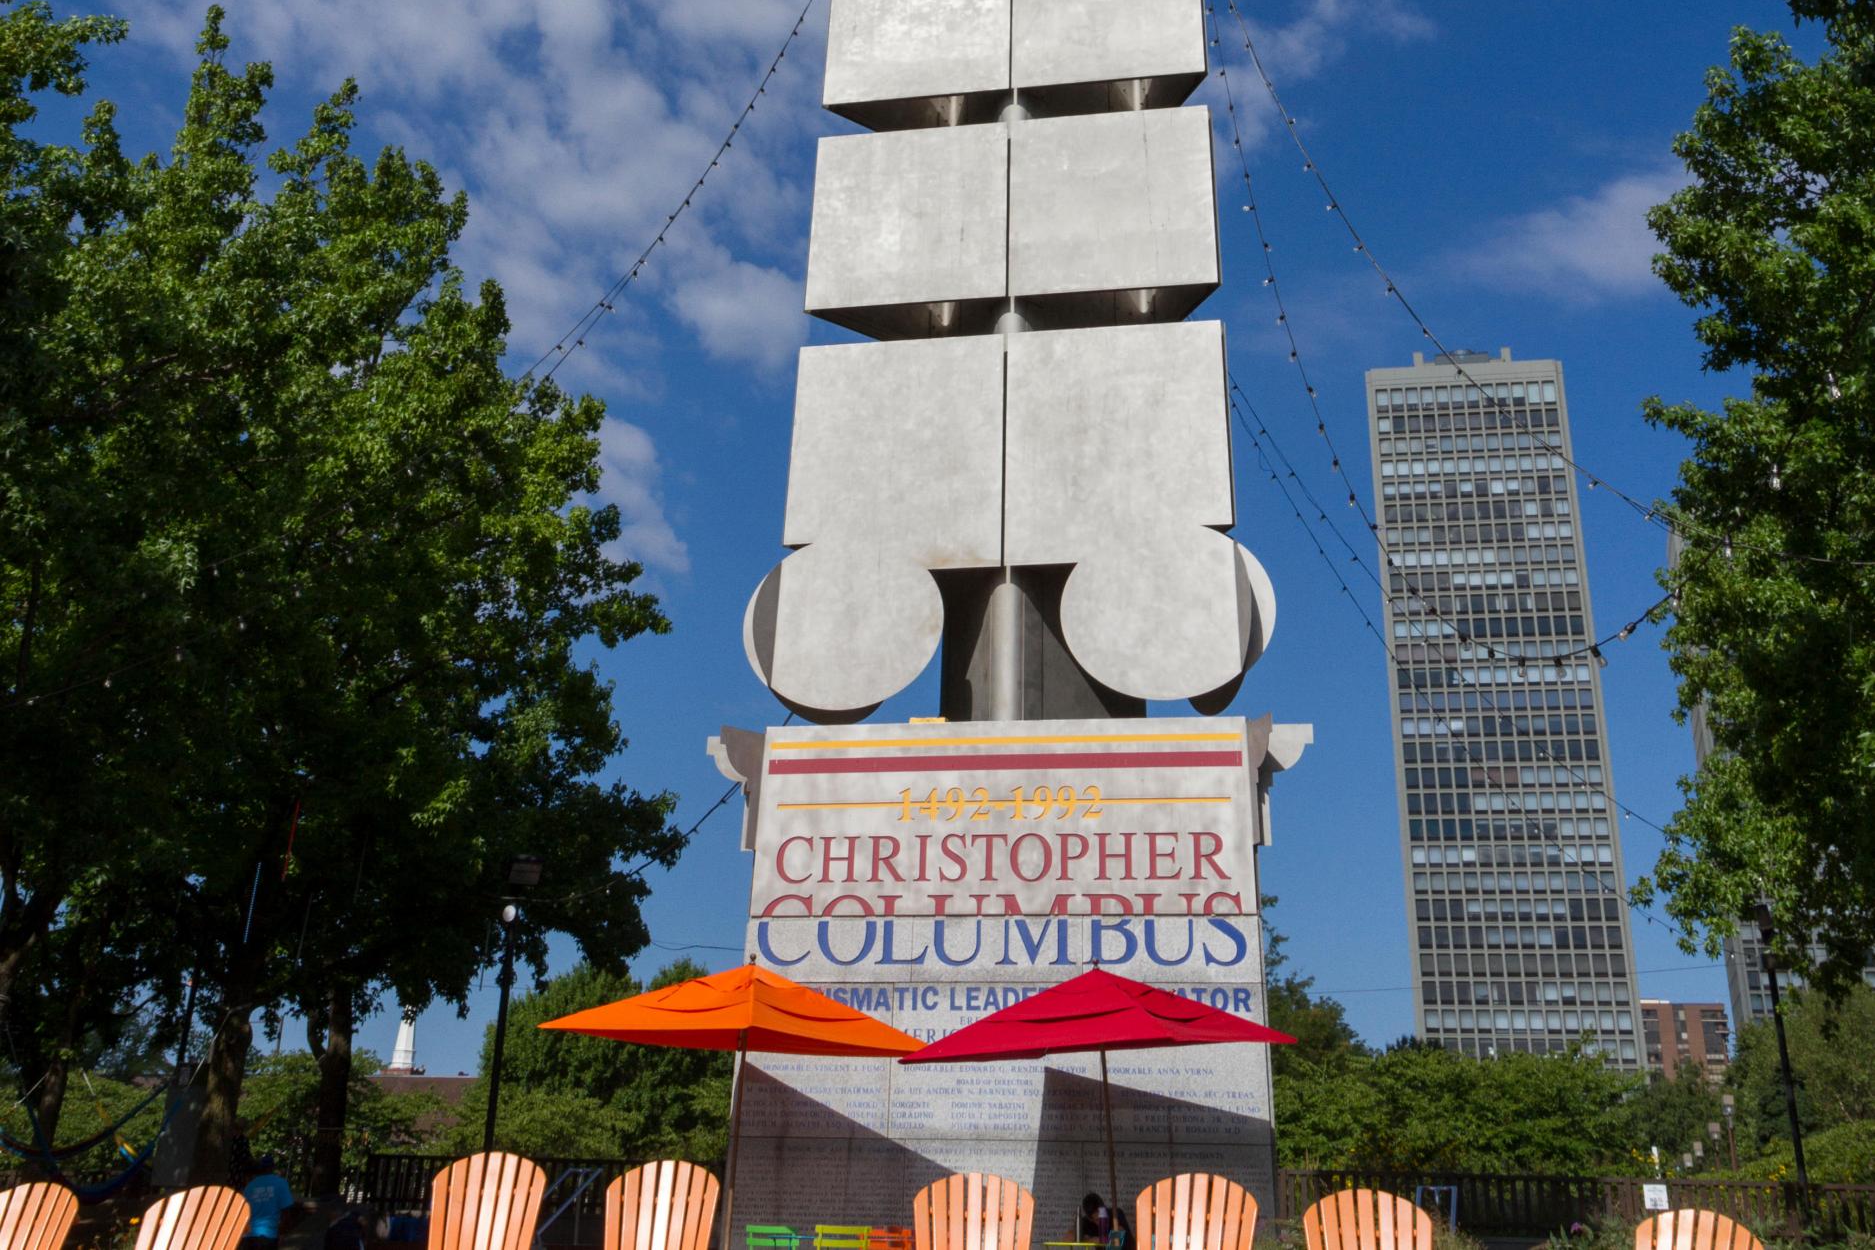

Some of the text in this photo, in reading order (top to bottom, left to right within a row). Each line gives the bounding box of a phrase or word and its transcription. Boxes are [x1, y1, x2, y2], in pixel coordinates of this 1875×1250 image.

[898, 785, 1104, 821] 1492-1992
[775, 831, 1232, 884] CHRISTOPHER
[757, 891, 1247, 967] COLUMBUS
